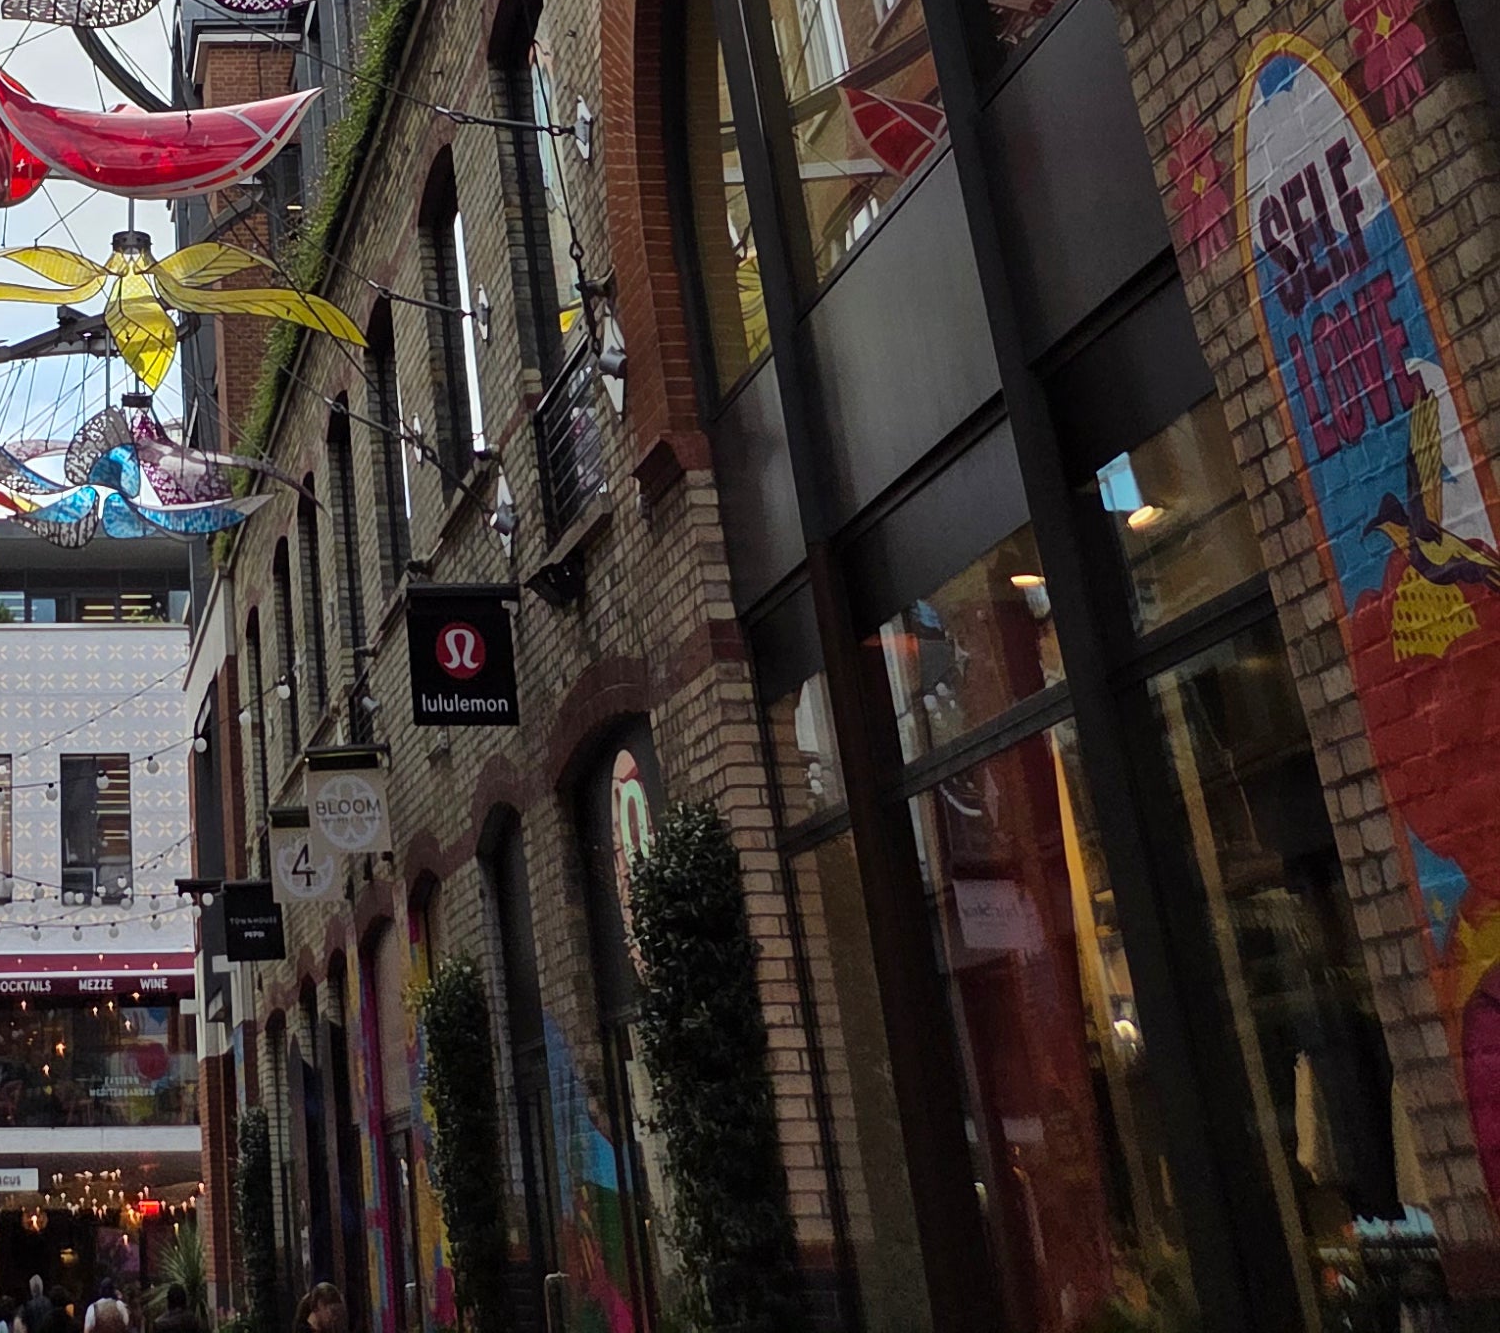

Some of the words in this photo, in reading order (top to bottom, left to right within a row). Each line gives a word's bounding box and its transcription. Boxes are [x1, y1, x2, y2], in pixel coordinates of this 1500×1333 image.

[1259, 136, 1369, 318] SELF
[1288, 270, 1428, 459] LOVE
[422, 693, 508, 712] lululemon
[315, 798, 381, 816] BLOOM
[291, 843, 317, 886] 4
[78, 978, 114, 992] MEZZE
[139, 977, 168, 990] WINE
